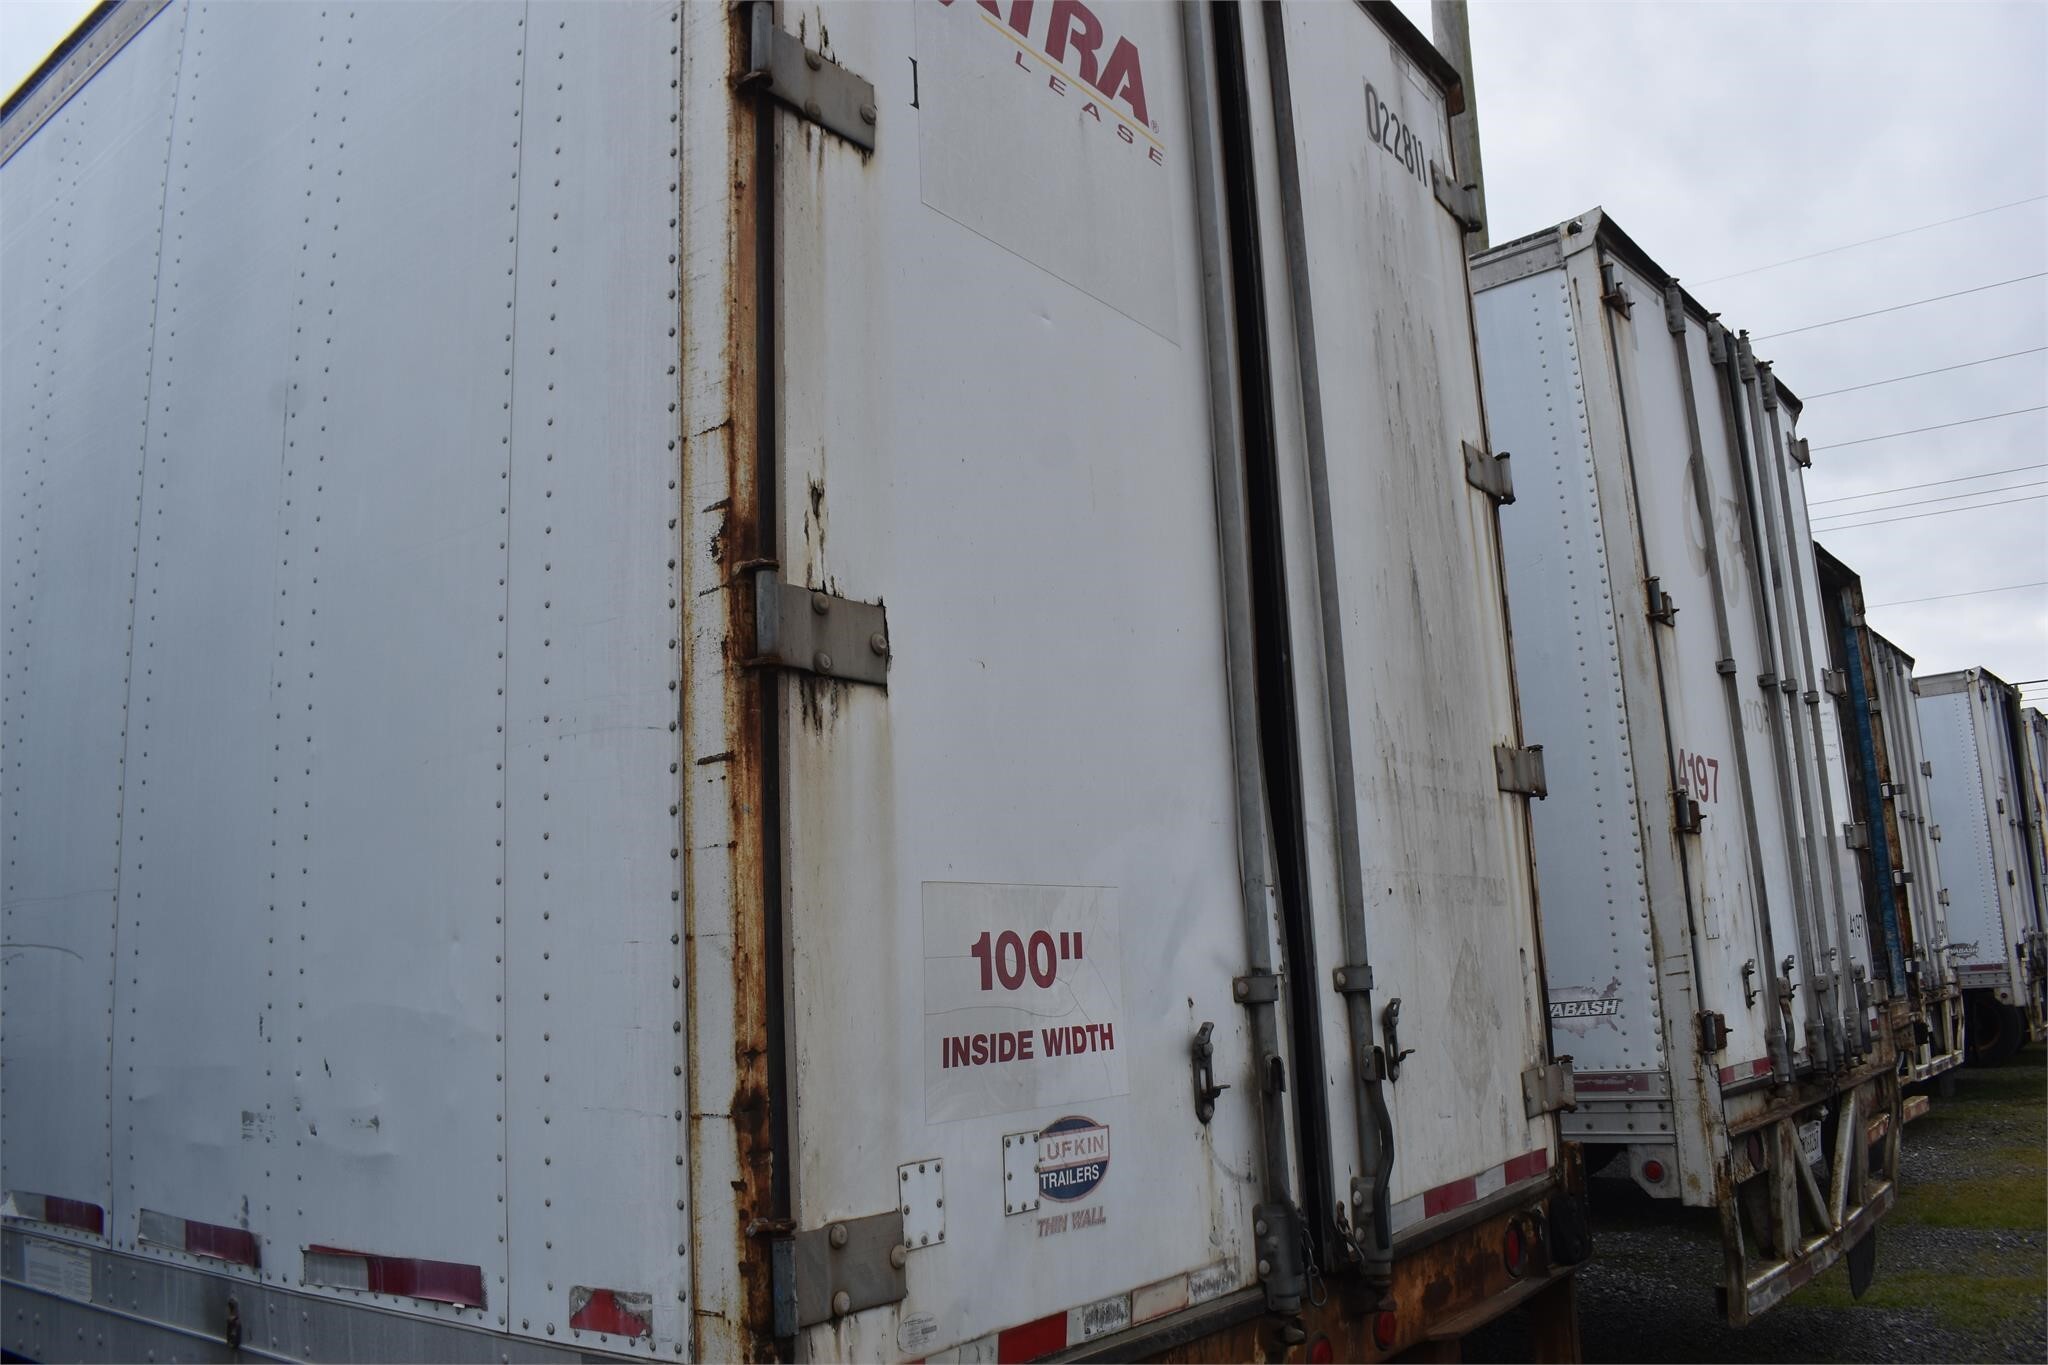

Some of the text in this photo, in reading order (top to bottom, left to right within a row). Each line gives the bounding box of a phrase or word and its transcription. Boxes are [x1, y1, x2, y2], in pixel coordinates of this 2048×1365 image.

[937, 0, 1149, 128] RA
[1015, 51, 1163, 167] LEASE
[1365, 83, 1428, 188] 022811
[1679, 748, 1719, 804] 4197
[971, 930, 1083, 991] 100"
[943, 1023, 1115, 1069] INSIDE WIDTH
[1040, 1135, 1104, 1162] UFKIN
[1040, 1164, 1100, 1190] TRAILERS
[1037, 1206, 1107, 1238] THIN WALL
